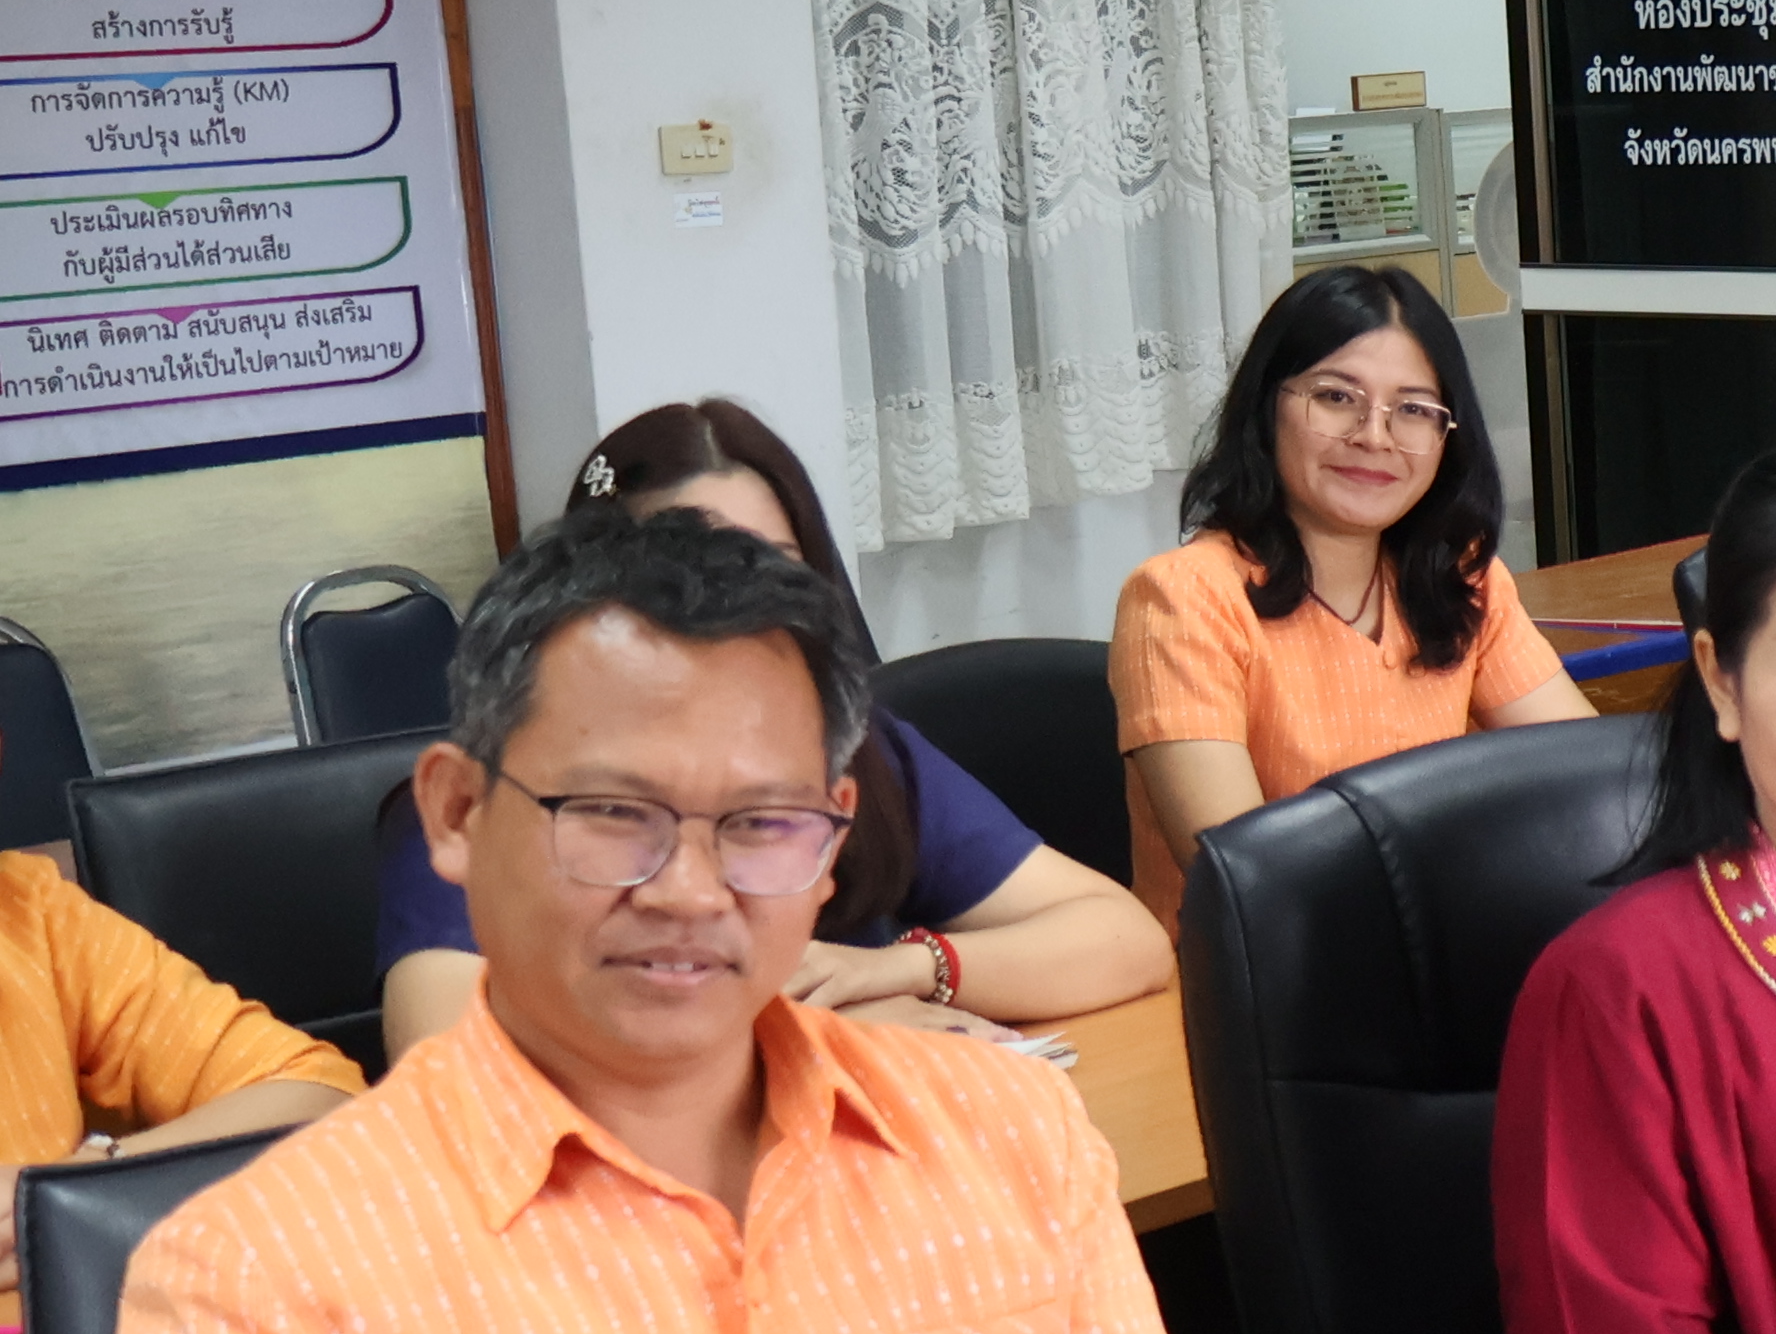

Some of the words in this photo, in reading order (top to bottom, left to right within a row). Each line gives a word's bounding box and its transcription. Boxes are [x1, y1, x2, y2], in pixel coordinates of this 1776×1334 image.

[91, 7, 236, 45] สร้างการรับรู้
[234, 78, 291, 105] (KM)
[85, 124, 180, 159] ปรับปรุง
[188, 117, 248, 147] แก้ไข
[50, 197, 294, 236] ประเมินผลรอบทิศทาง
[62, 236, 293, 285] กับผู้มีส่วนได้ส่วนเสีย
[26, 323, 91, 355] นิเทศ
[97, 317, 179, 348] ติดตาม
[187, 305, 288, 342] สนับสนุน
[294, 297, 373, 329] ส่งเสริม
